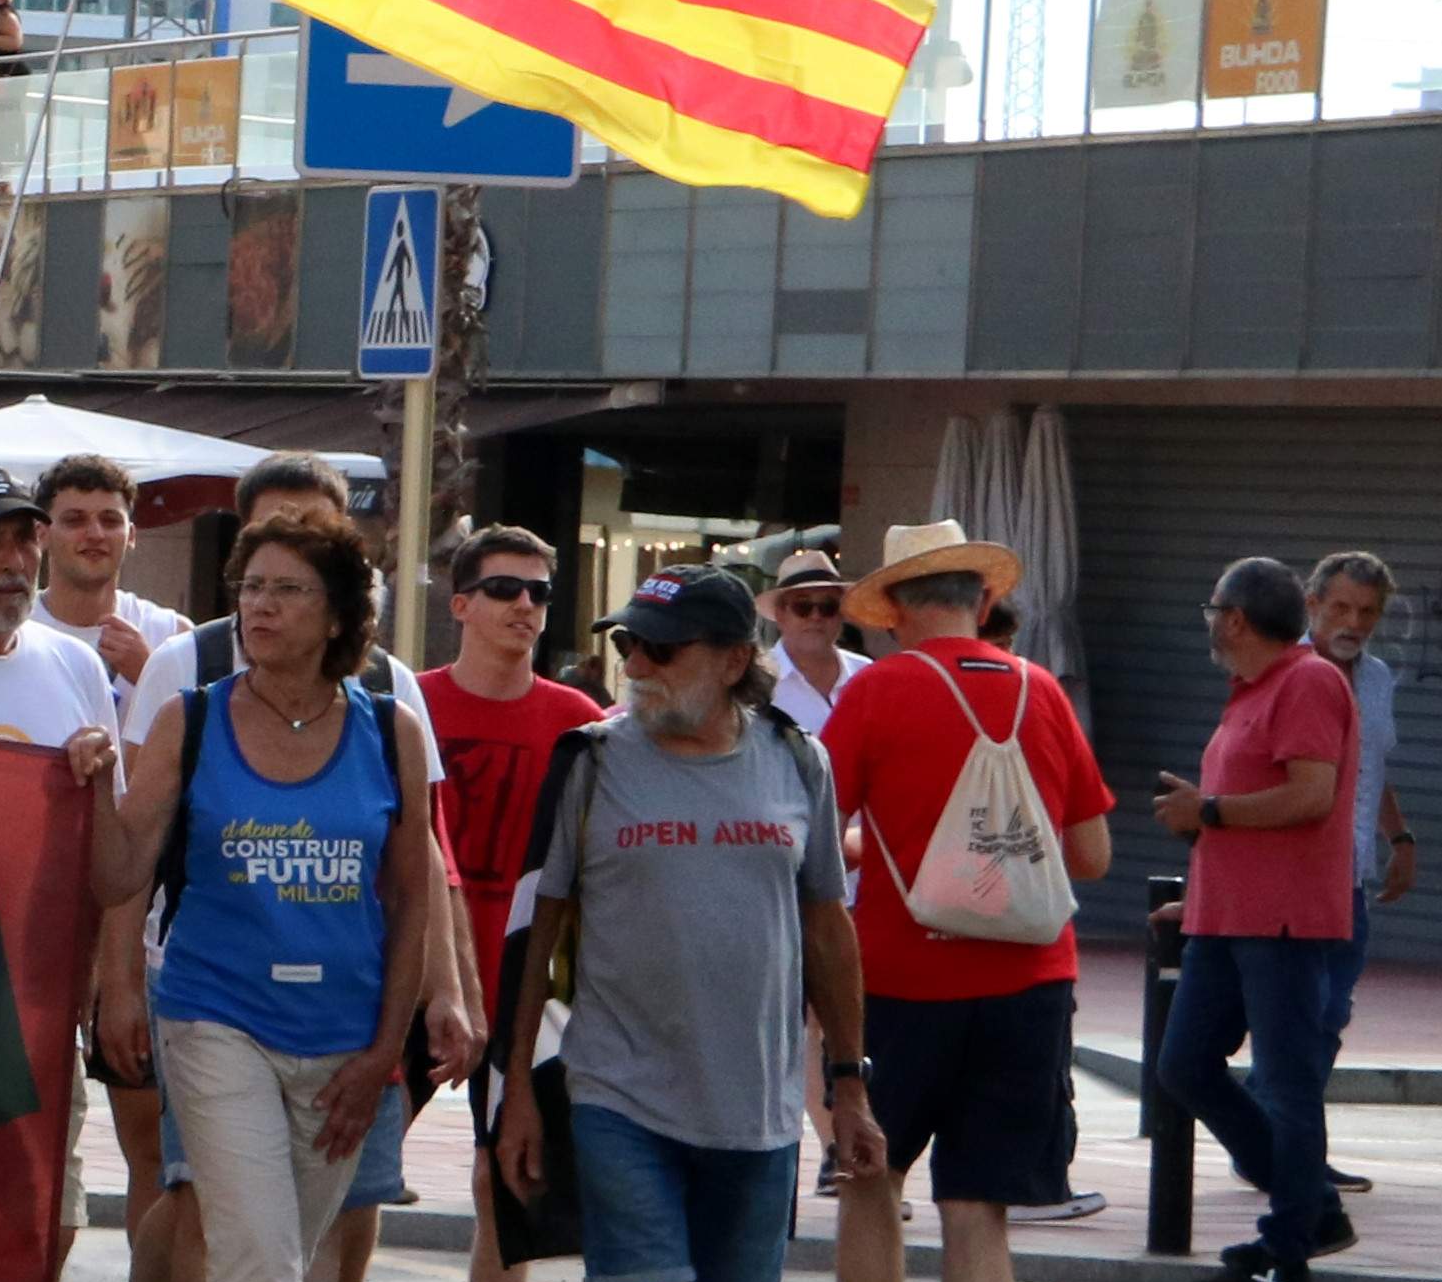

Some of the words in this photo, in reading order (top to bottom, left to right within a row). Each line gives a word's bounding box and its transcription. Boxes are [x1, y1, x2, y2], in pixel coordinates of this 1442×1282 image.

[616, 821, 699, 848] OPEN
[714, 821, 796, 847] ARMS
[221, 839, 363, 858] CONSTRUIR
[247, 858, 363, 884] FUTUR
[278, 885, 362, 902] MILLOR
